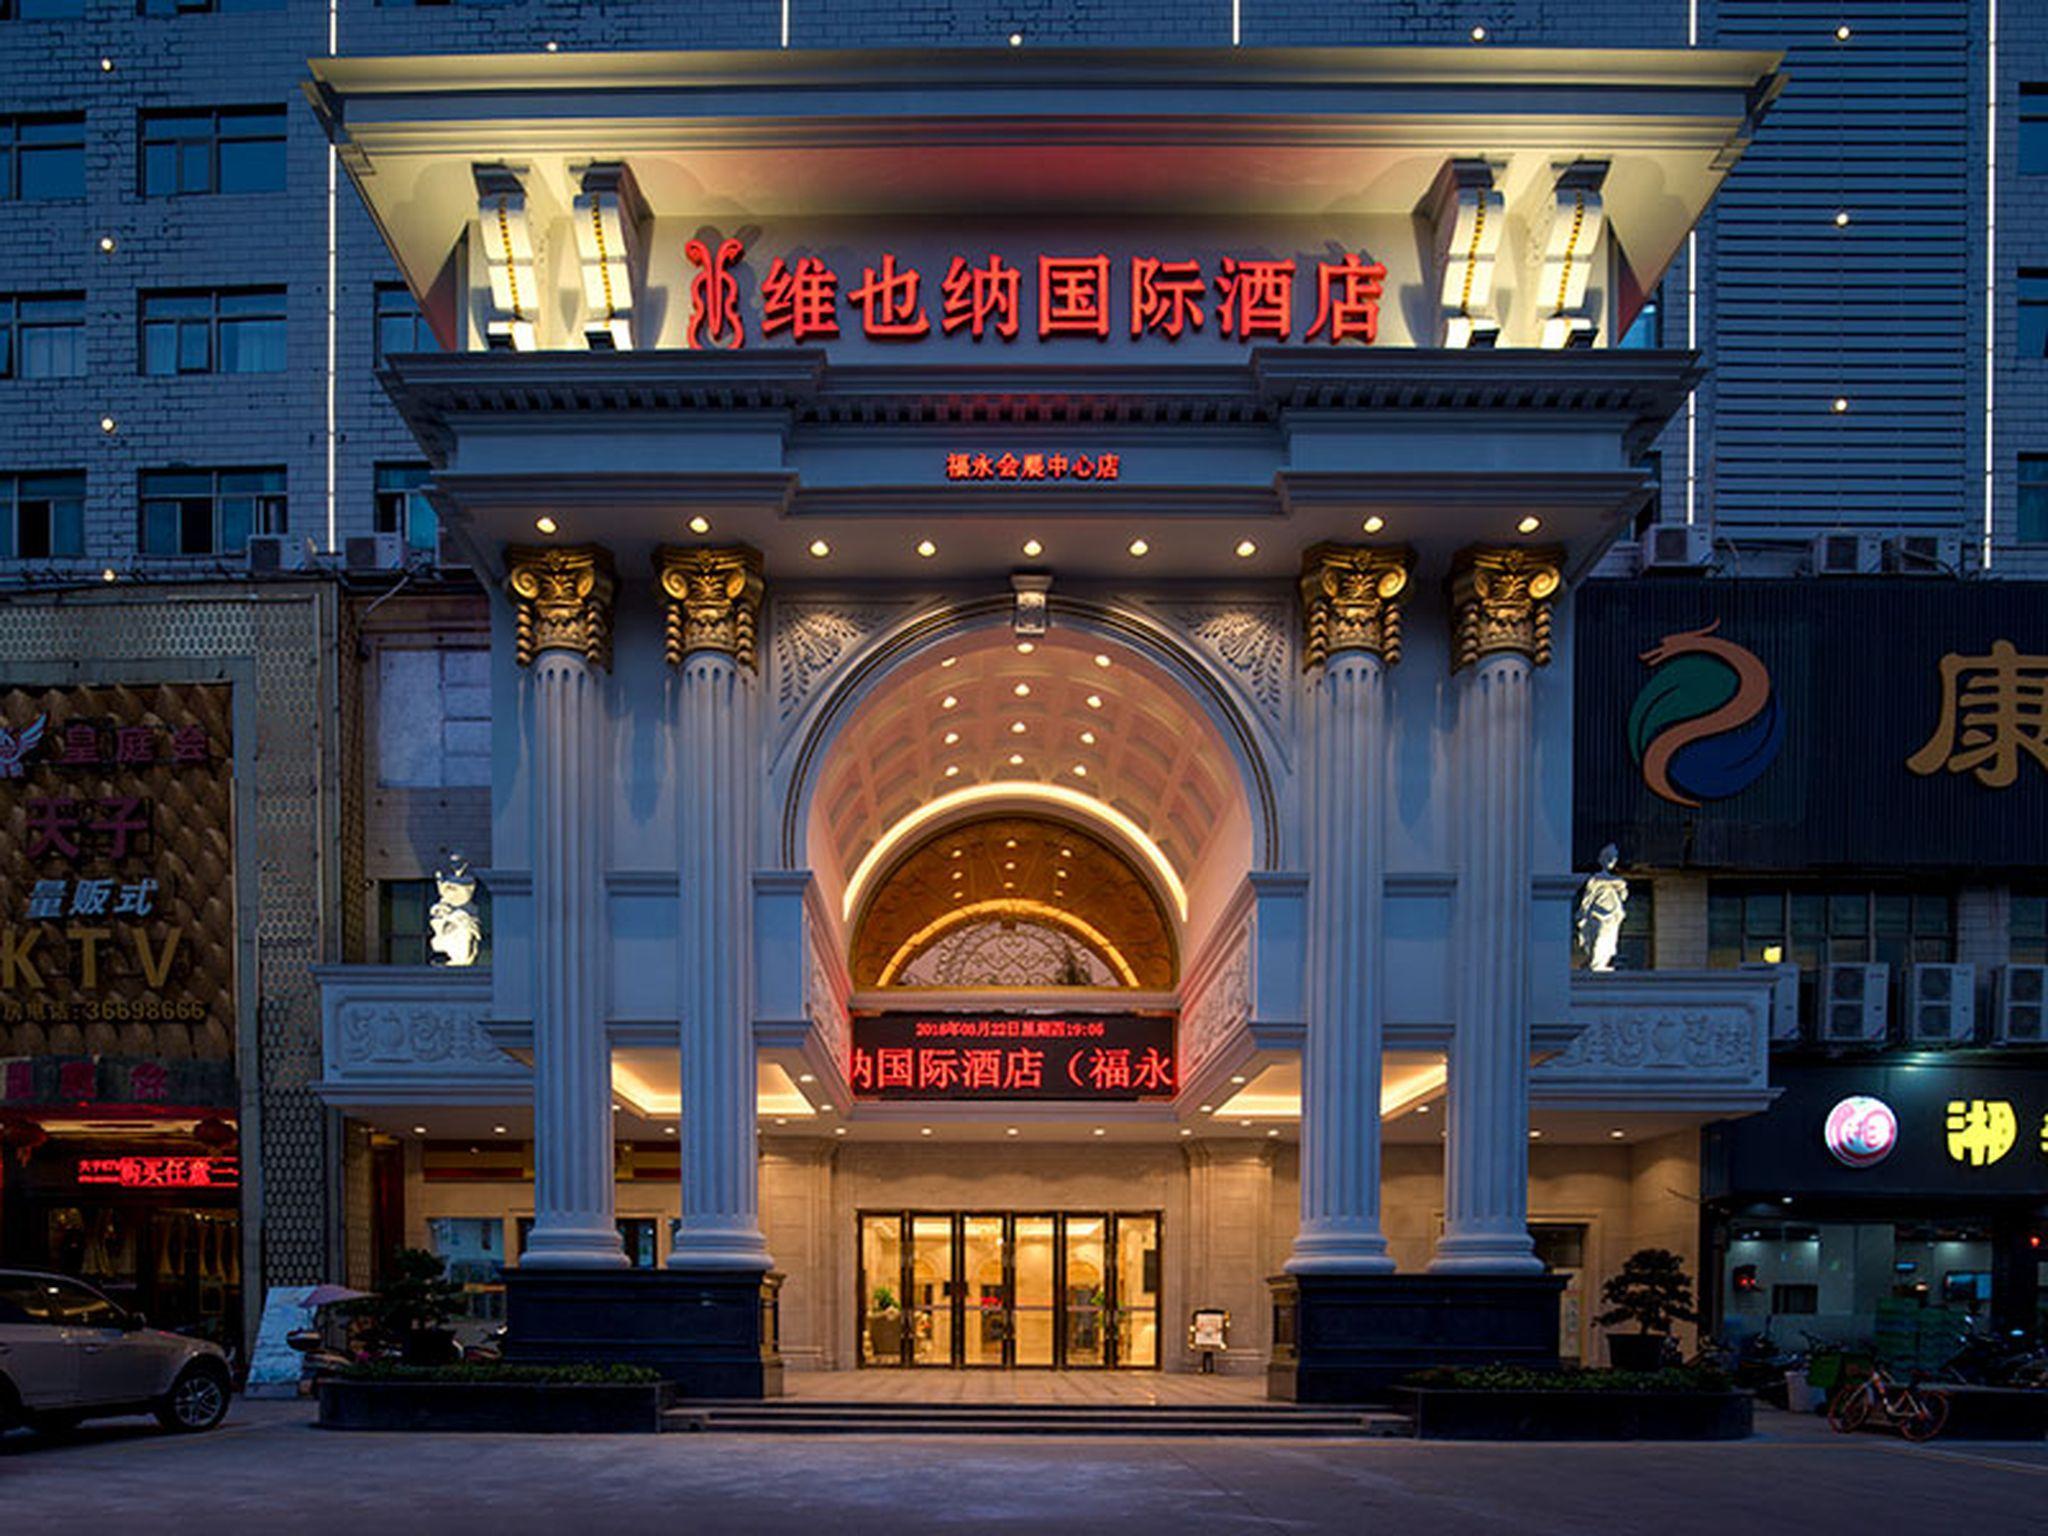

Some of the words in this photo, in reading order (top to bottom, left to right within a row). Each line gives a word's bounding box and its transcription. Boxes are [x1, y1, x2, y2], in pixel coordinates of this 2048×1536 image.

[761, 252, 1389, 344] 维也纳国际酒店
[946, 452, 1121, 480] 福永会展中心店
[1905, 638, 2048, 788] 康
[0, 928, 182, 989] KTV
